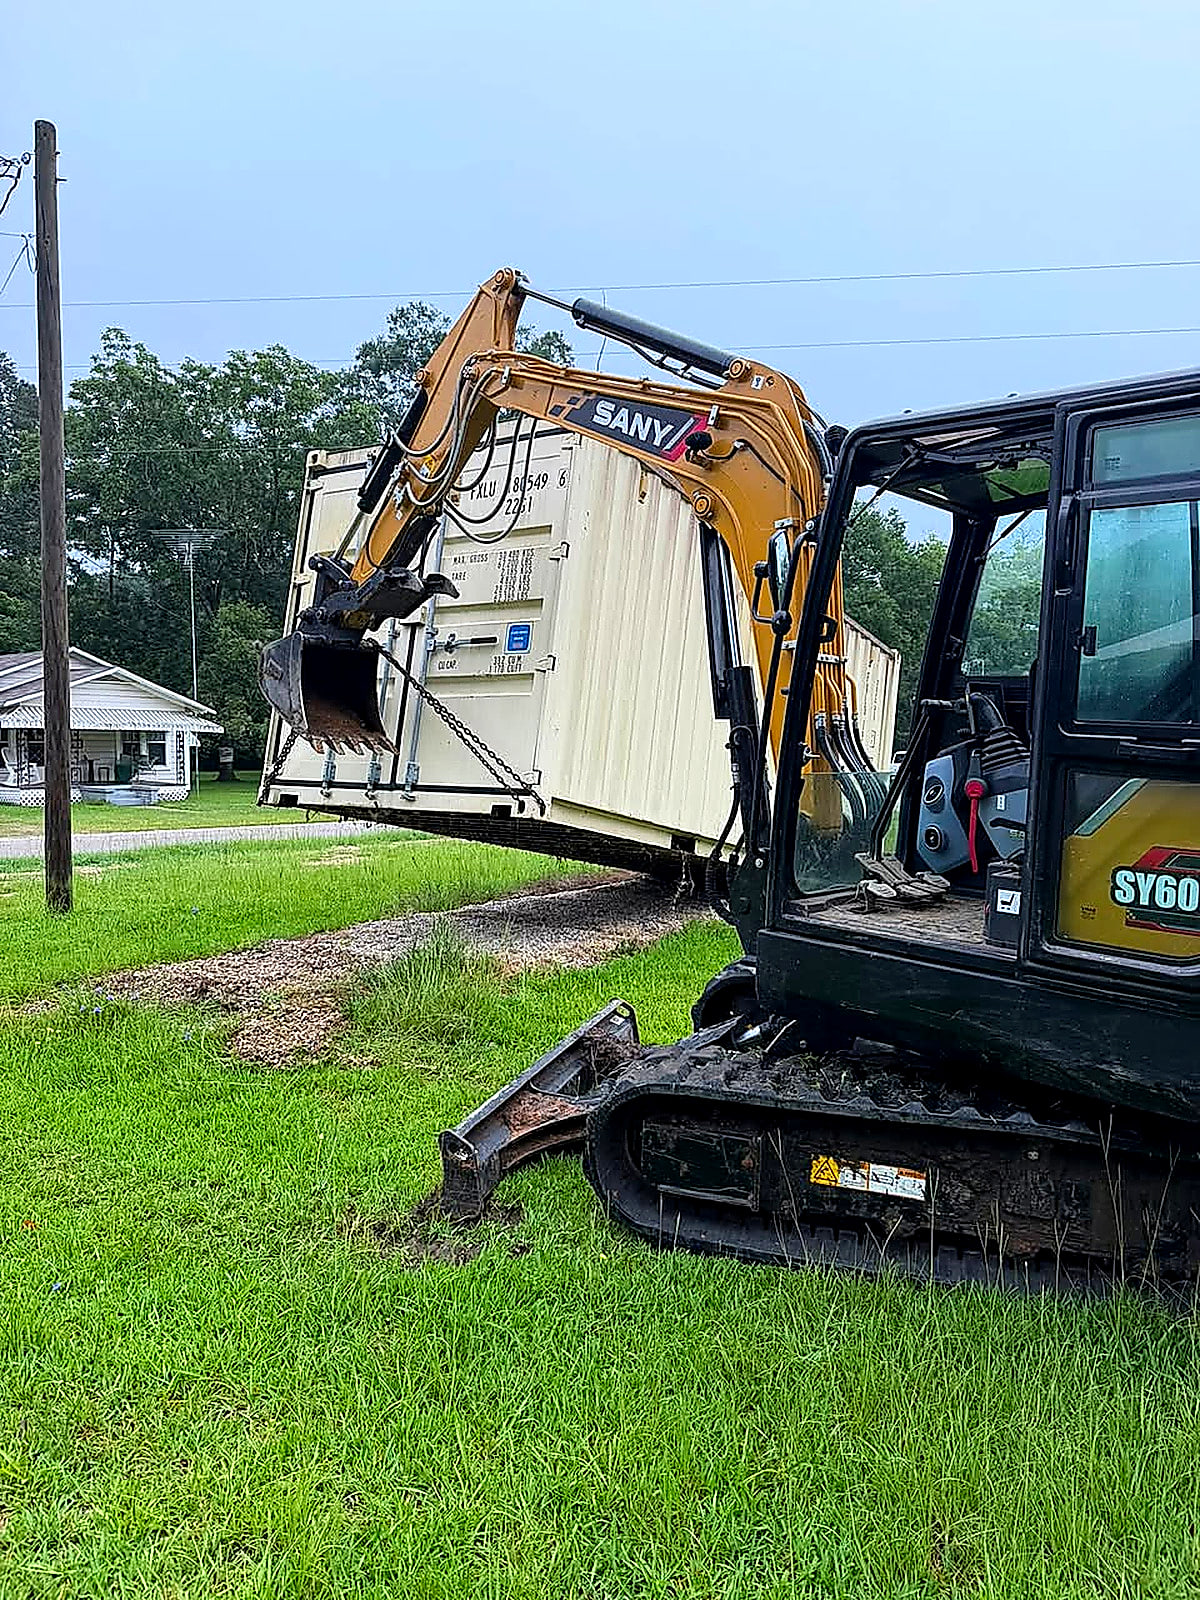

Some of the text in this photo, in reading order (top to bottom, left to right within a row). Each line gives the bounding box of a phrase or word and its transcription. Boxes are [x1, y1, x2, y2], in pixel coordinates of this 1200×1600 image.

[592, 400, 674, 447] SANY
[559, 470, 567, 487] 6
[1115, 870, 1199, 911] SY60
